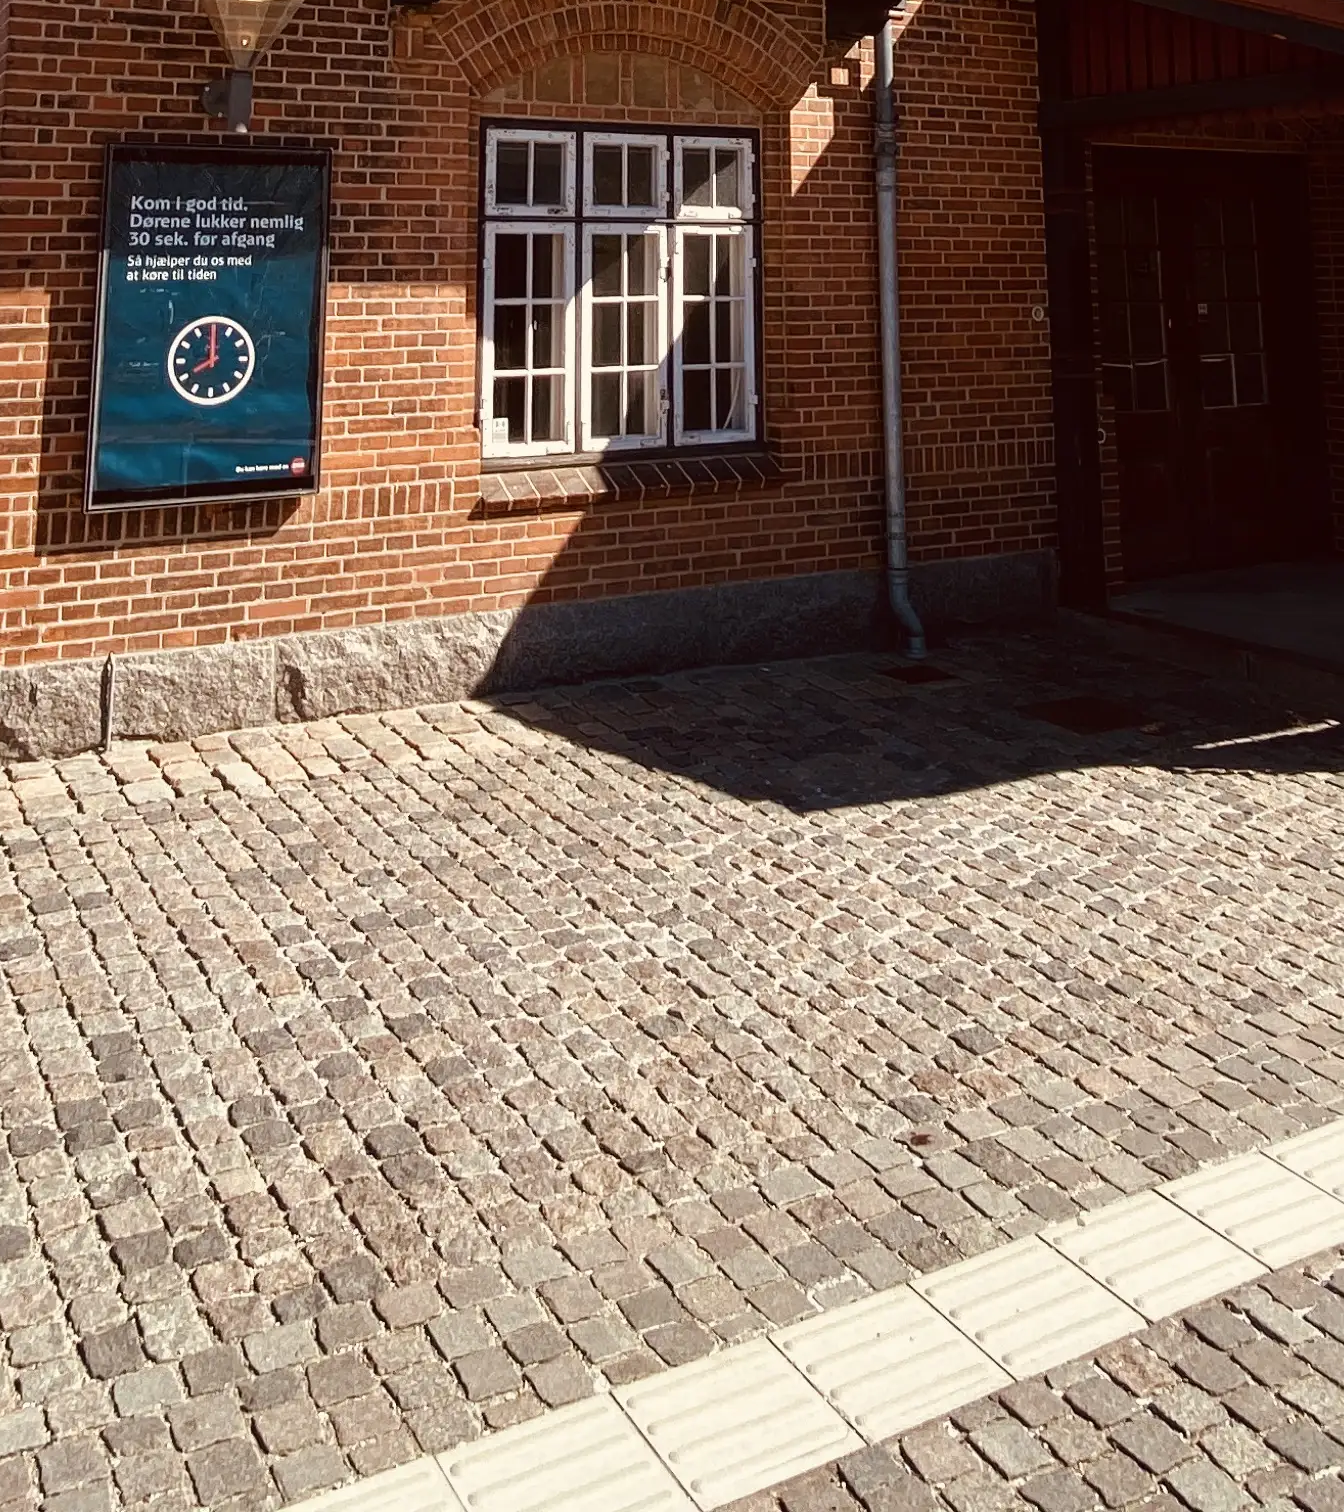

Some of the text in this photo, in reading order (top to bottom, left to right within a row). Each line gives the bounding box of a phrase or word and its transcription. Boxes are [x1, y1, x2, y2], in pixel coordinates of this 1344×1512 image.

[131, 195, 171, 211] Kom
[185, 196, 217, 213] god
[221, 196, 249, 212] tid.
[130, 213, 304, 231] Dørene lukker nemlig
[128, 231, 276, 248] 30 sek. før afgang
[127, 254, 253, 270] Så hjælper du os med
[126, 268, 217, 281] at køre til tiden
